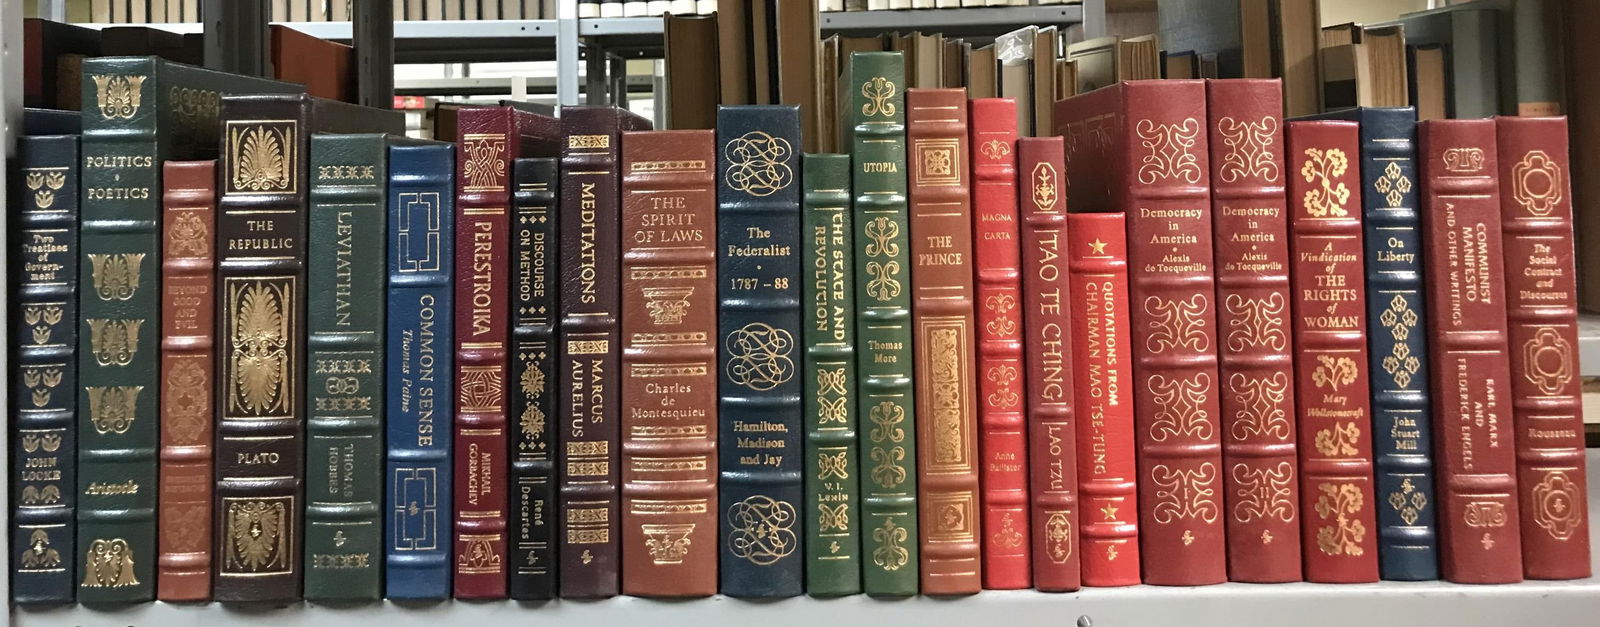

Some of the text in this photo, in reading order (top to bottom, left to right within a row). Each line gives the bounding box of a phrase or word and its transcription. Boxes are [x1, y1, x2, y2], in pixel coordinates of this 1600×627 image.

[86, 156, 152, 168] POLITICS
[863, 162, 897, 173] UTOPIA
[88, 187, 149, 199] POETICS
[650, 197, 686, 210] THE
[981, 213, 1012, 222] MAGNA
[1140, 207, 1202, 220] Democracy
[1222, 206, 1280, 218] Democracy
[247, 220, 273, 231] THE
[641, 213, 696, 227] SPIRIT
[1168, 221, 1179, 230] in
[1248, 219, 1258, 229] in
[634, 229, 704, 243] OF LAWS
[746, 227, 771, 239] The
[984, 232, 1012, 240] CARTA
[1150, 233, 1198, 244] America
[1231, 232, 1275, 242] America
[229, 238, 293, 250] REPUBLIC
[581, 182, 596, 304] MEDITATIONS
[927, 235, 953, 248] THE
[1324, 241, 1333, 251] A
[1387, 237, 1404, 248] On
[727, 244, 791, 257] Federalist
[1533, 243, 1551, 253] The
[38, 253, 48, 262] of
[919, 253, 963, 266] PRINCE
[1162, 254, 1190, 263] Alexis
[1242, 252, 1268, 261] Alexis
[1300, 252, 1357, 262] Vindication
[1377, 251, 1415, 264] Liberty
[1529, 255, 1557, 265] Social
[336, 211, 352, 326] LEVIATHAN
[520, 229, 530, 301] ON METHOD
[534, 233, 544, 297] DISCOURSE
[1145, 263, 1207, 274] de Tocqueville
[1225, 262, 1282, 272] de Tocqueville
[1325, 262, 1336, 274] of
[1446, 202, 1462, 327] AND OTHER WRITINGS
[1462, 226, 1477, 301] MANIFESTO
[1476, 222, 1491, 304] COMMUNIST
[832, 212, 845, 340] THE STATE AND
[1524, 267, 1563, 276] Contract
[473, 221, 492, 336] PERESTROIKA
[730, 278, 759, 290] 1787
[774, 277, 789, 290] 88
[814, 226, 828, 332] REVOLUTION
[1315, 275, 1346, 287] THE
[1536, 278, 1554, 288] and
[1303, 289, 1357, 301] RIGHTS
[173, 297, 201, 306] GOOD
[175, 308, 197, 318] AND
[1326, 302, 1338, 315] of
[1039, 234, 1064, 401] TAO TE CHING
[1304, 316, 1359, 328] WOMAN
[175, 320, 198, 329] EVIL
[868, 340, 902, 350] Thomas
[1102, 281, 1119, 406] QUOTATIONS FROM
[874, 353, 897, 363] More
[401, 329, 414, 413] Thomas Paine
[418, 294, 435, 447] COMMON SENSE
[1086, 282, 1107, 475] CHAIRMAN MAO TSE-TUNG
[591, 359, 604, 424] MARCUS
[645, 382, 692, 394] Charles
[572, 360, 584, 438] AURELIUS
[661, 396, 676, 406] de
[1322, 394, 1348, 406] Mary
[631, 407, 705, 421] Montesquieu
[1457, 357, 1473, 470] FREDERICK ENGELS
[1474, 401, 1484, 428] AND
[1486, 378, 1498, 448] KARL MARX
[733, 421, 789, 433] Hamilton,
[1393, 416, 1416, 428] John
[1391, 428, 1420, 438] Stuart
[1528, 428, 1576, 439] Rousseau
[737, 437, 785, 448] Madison
[1396, 440, 1417, 450] Mill
[25, 457, 57, 468] JOHN
[238, 452, 279, 464] PLATO
[740, 454, 782, 468] and Jay
[994, 452, 1015, 461] Anne
[1048, 425, 1063, 490] LAO TZU
[22, 470, 61, 481] LOCKE
[329, 447, 338, 494] HOBBES
[343, 443, 354, 498] THOMAS
[468, 443, 478, 506] GORBACHEV
[481, 452, 491, 496] MIKHAIL
[84, 479, 139, 495] Aristotle
[521, 487, 531, 540] Descartes
[534, 499, 544, 526] René
